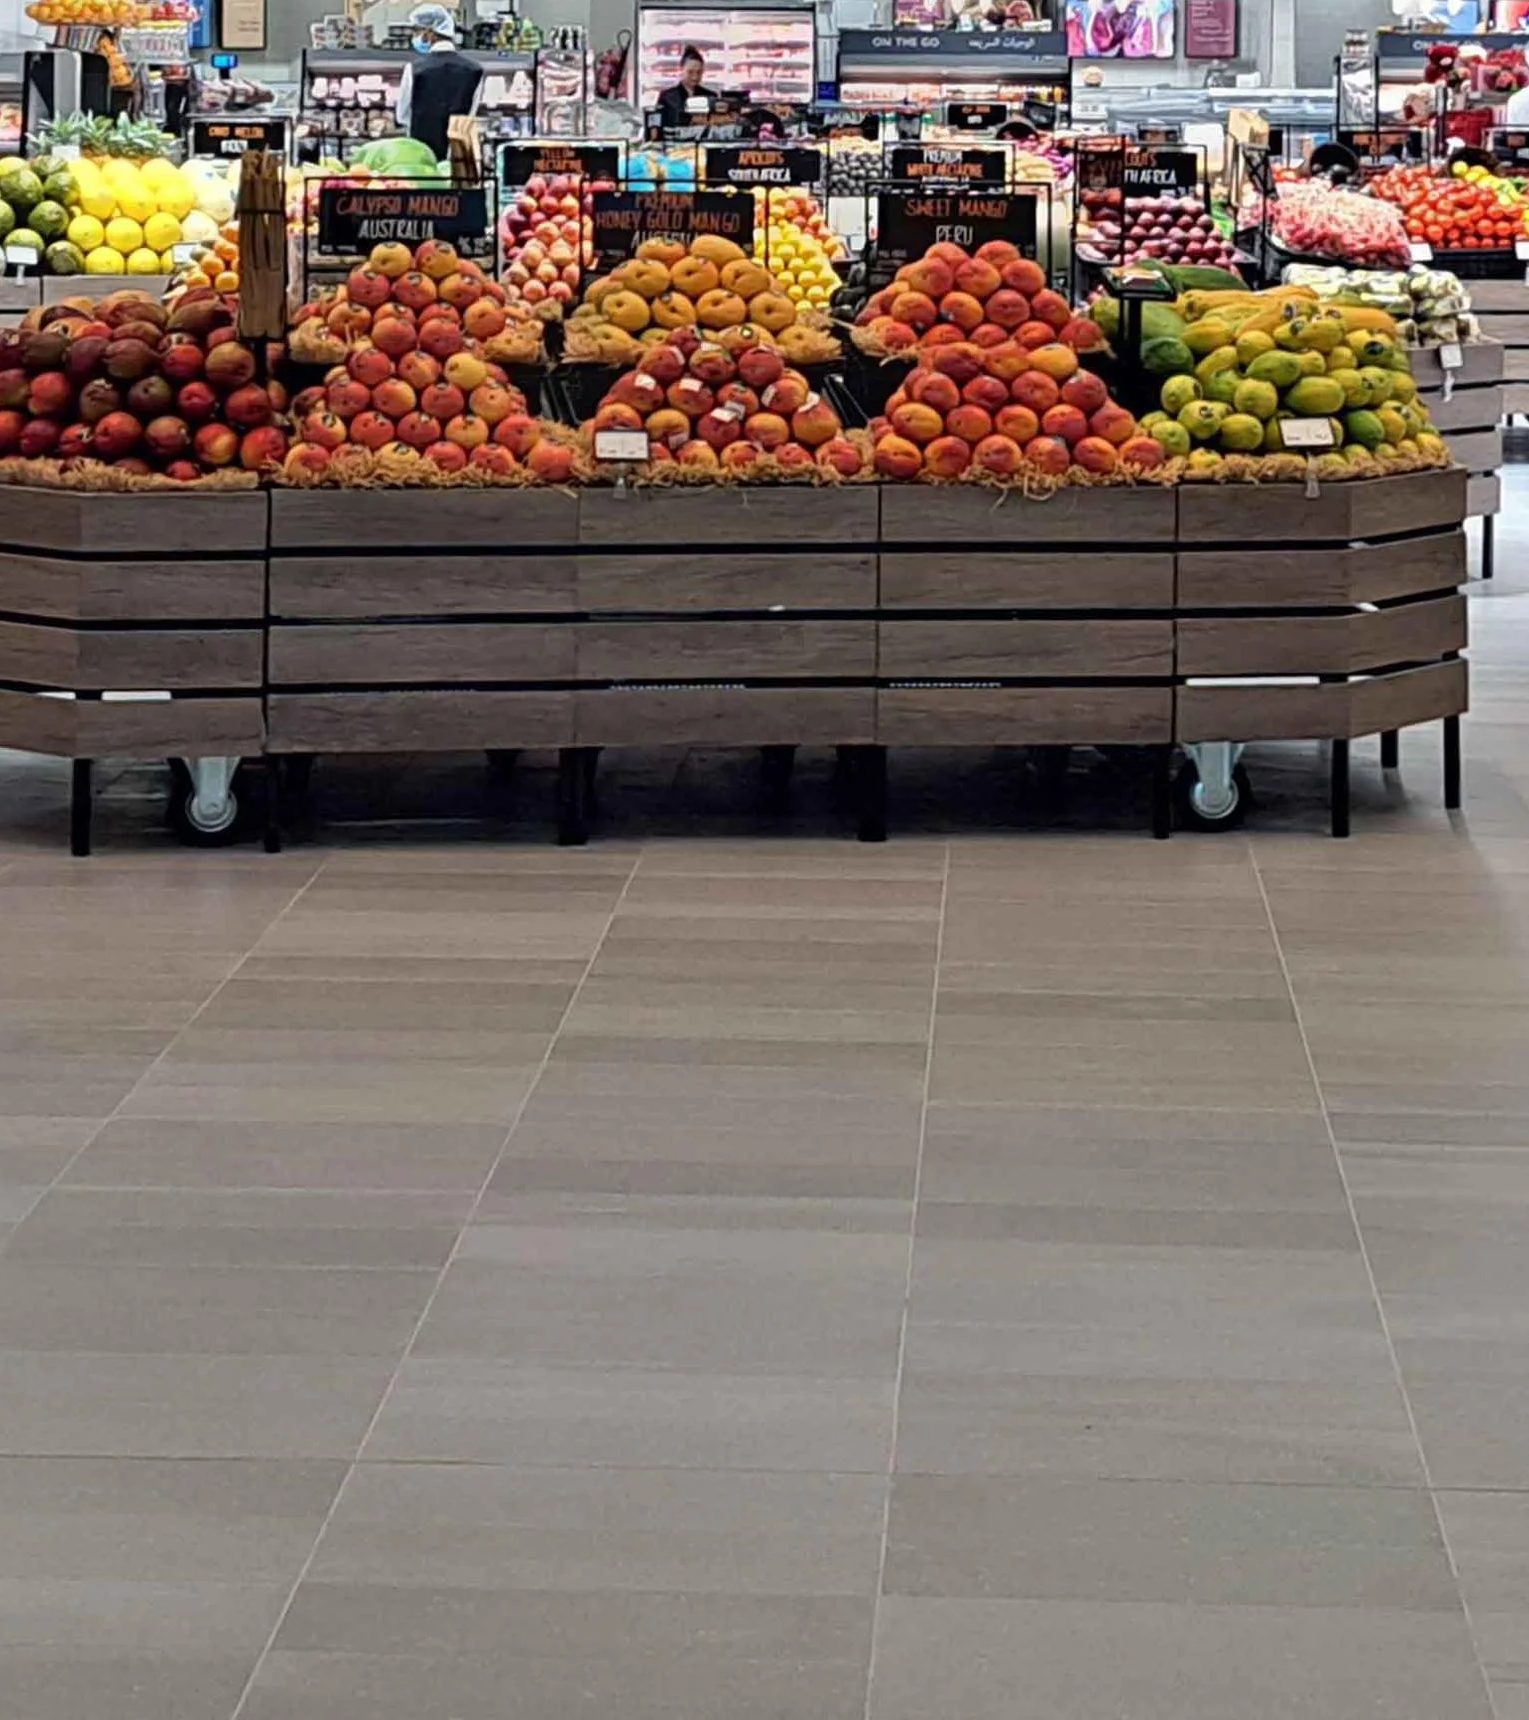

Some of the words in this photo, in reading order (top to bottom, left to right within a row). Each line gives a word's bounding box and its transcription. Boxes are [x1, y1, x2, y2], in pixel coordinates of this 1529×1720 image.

[872, 36, 892, 48] ON
[895, 36, 918, 48] THE
[921, 36, 940, 48] GO
[335, 195, 402, 216] CALYPSO
[408, 195, 460, 217] MANGO
[905, 199, 951, 217] SWEET
[958, 199, 1008, 218] MANGO
[357, 219, 435, 240] AUSTRALIA
[596, 210, 642, 229] HONEY
[646, 210, 684, 230] GOLD
[689, 211, 741, 233] MANGO
[935, 225, 974, 245] PERU
